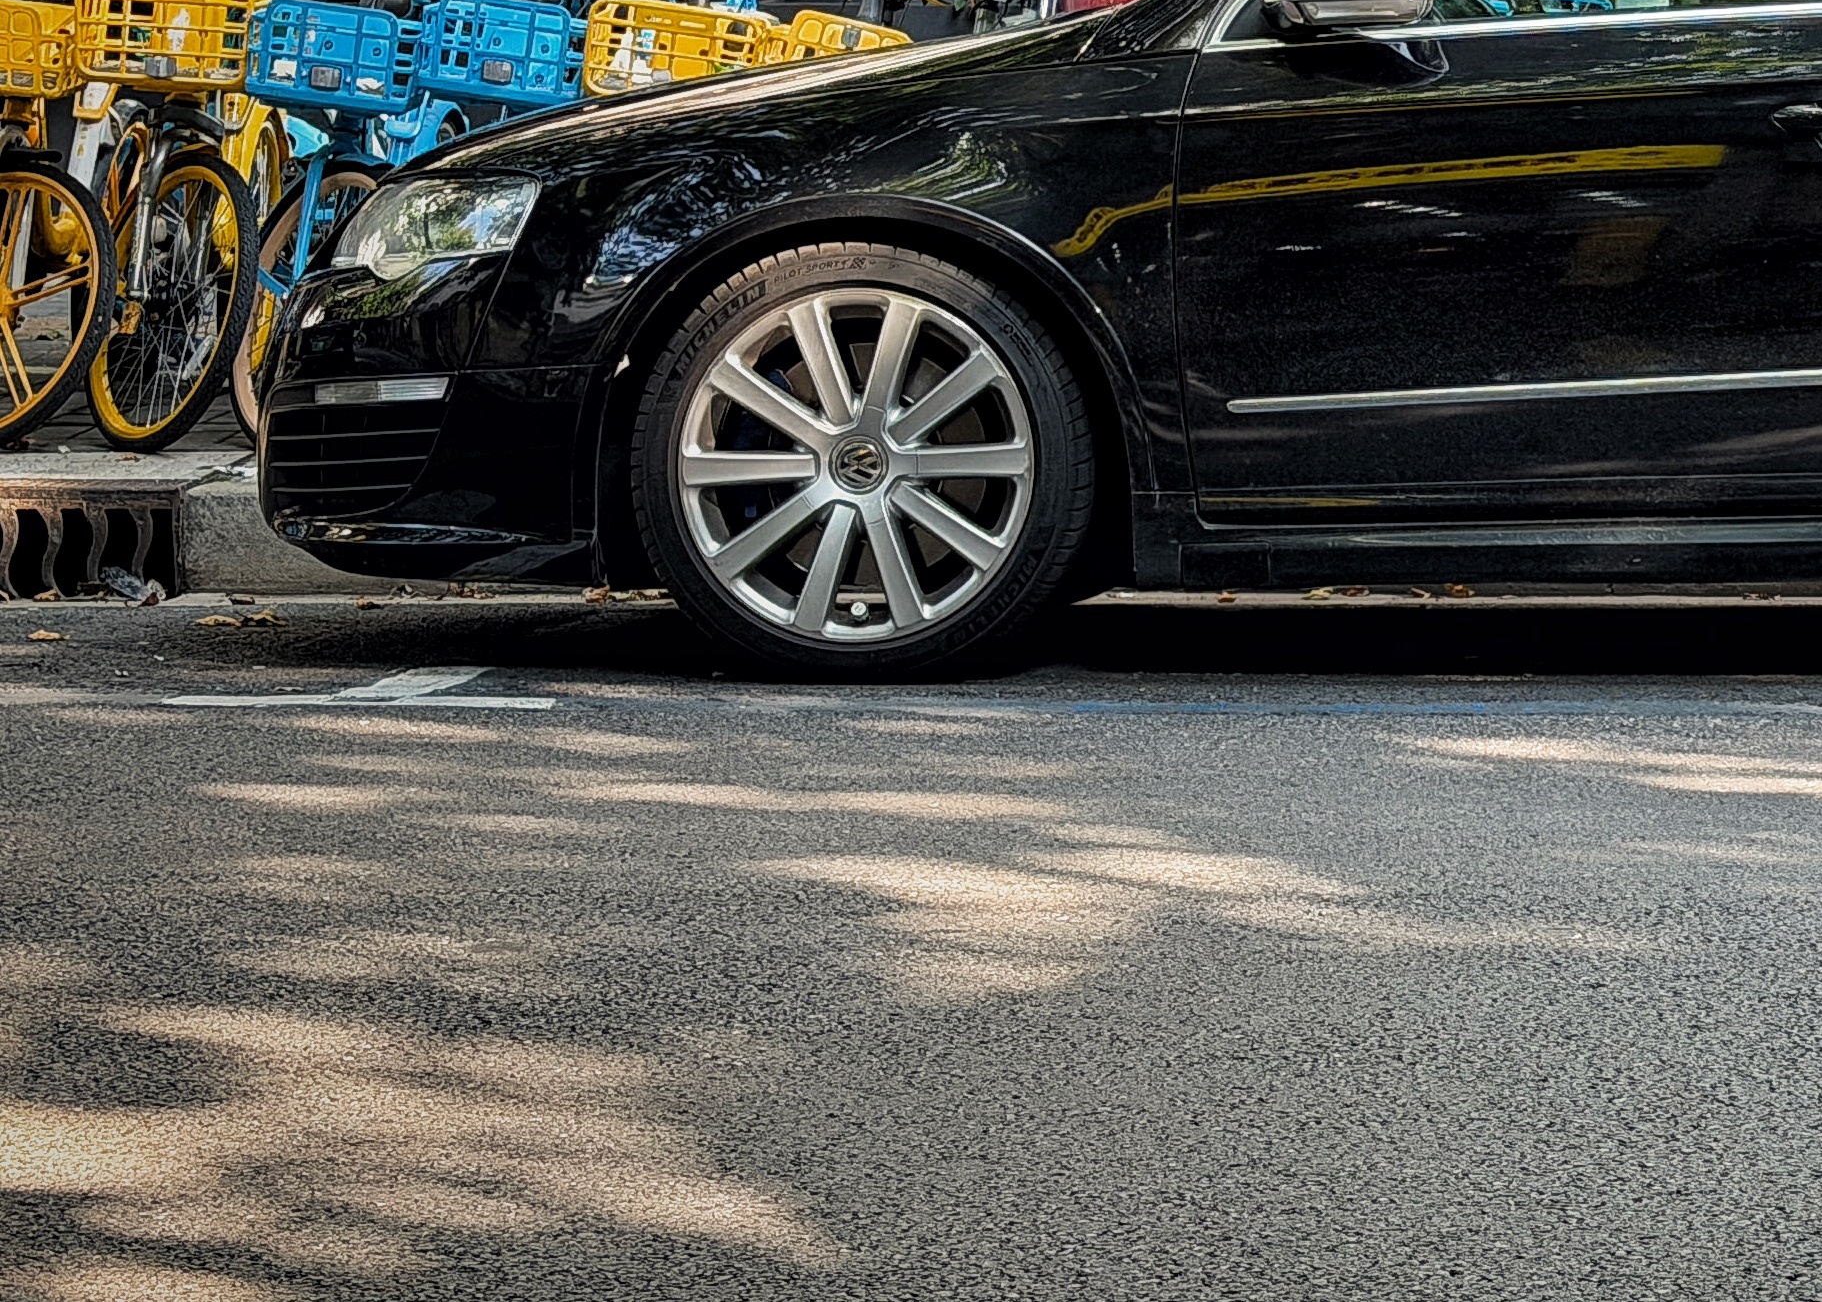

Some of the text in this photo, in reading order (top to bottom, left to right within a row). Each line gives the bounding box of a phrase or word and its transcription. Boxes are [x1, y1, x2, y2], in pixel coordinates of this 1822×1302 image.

[773, 267, 801, 286] PILOT
[804, 259, 840, 274] SPORT
[674, 280, 763, 378] MICHELIN
